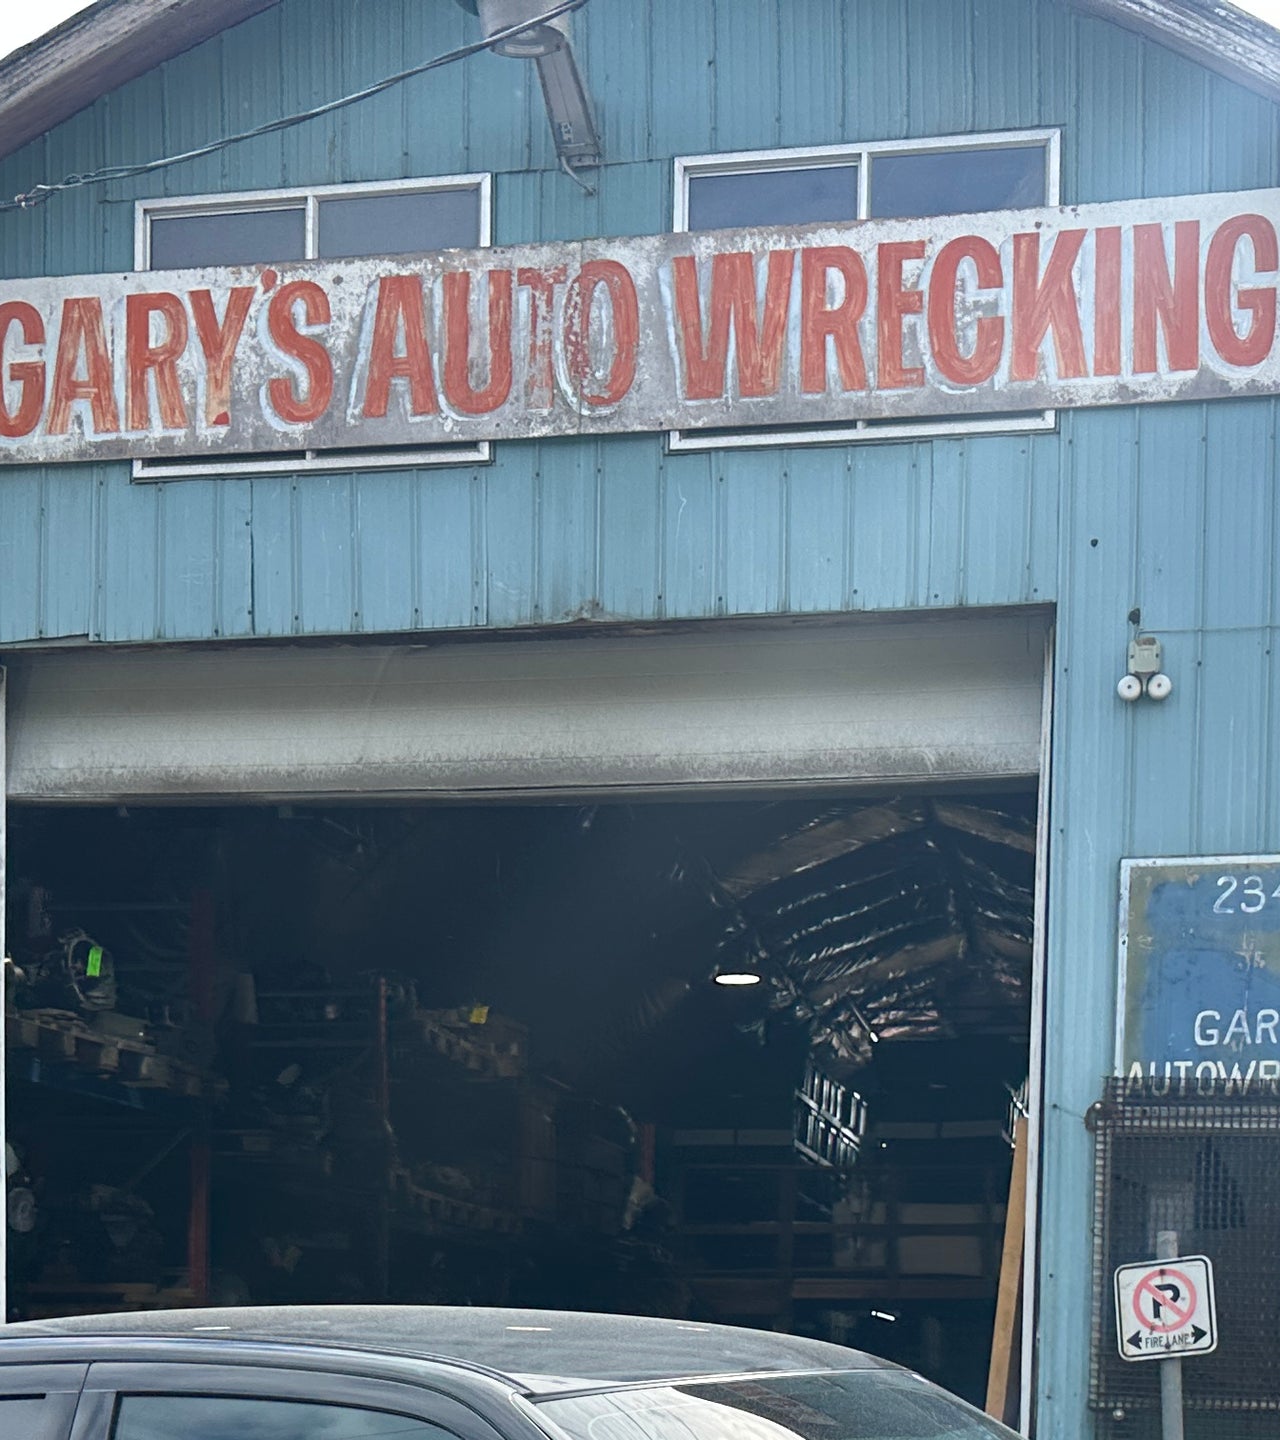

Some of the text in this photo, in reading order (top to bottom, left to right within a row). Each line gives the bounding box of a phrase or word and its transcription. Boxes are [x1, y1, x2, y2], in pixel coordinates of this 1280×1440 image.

[362, 258, 641, 420] AUTO
[672, 213, 1280, 400] WRECKING
[1145, 1336, 1164, 1349] FIRE
